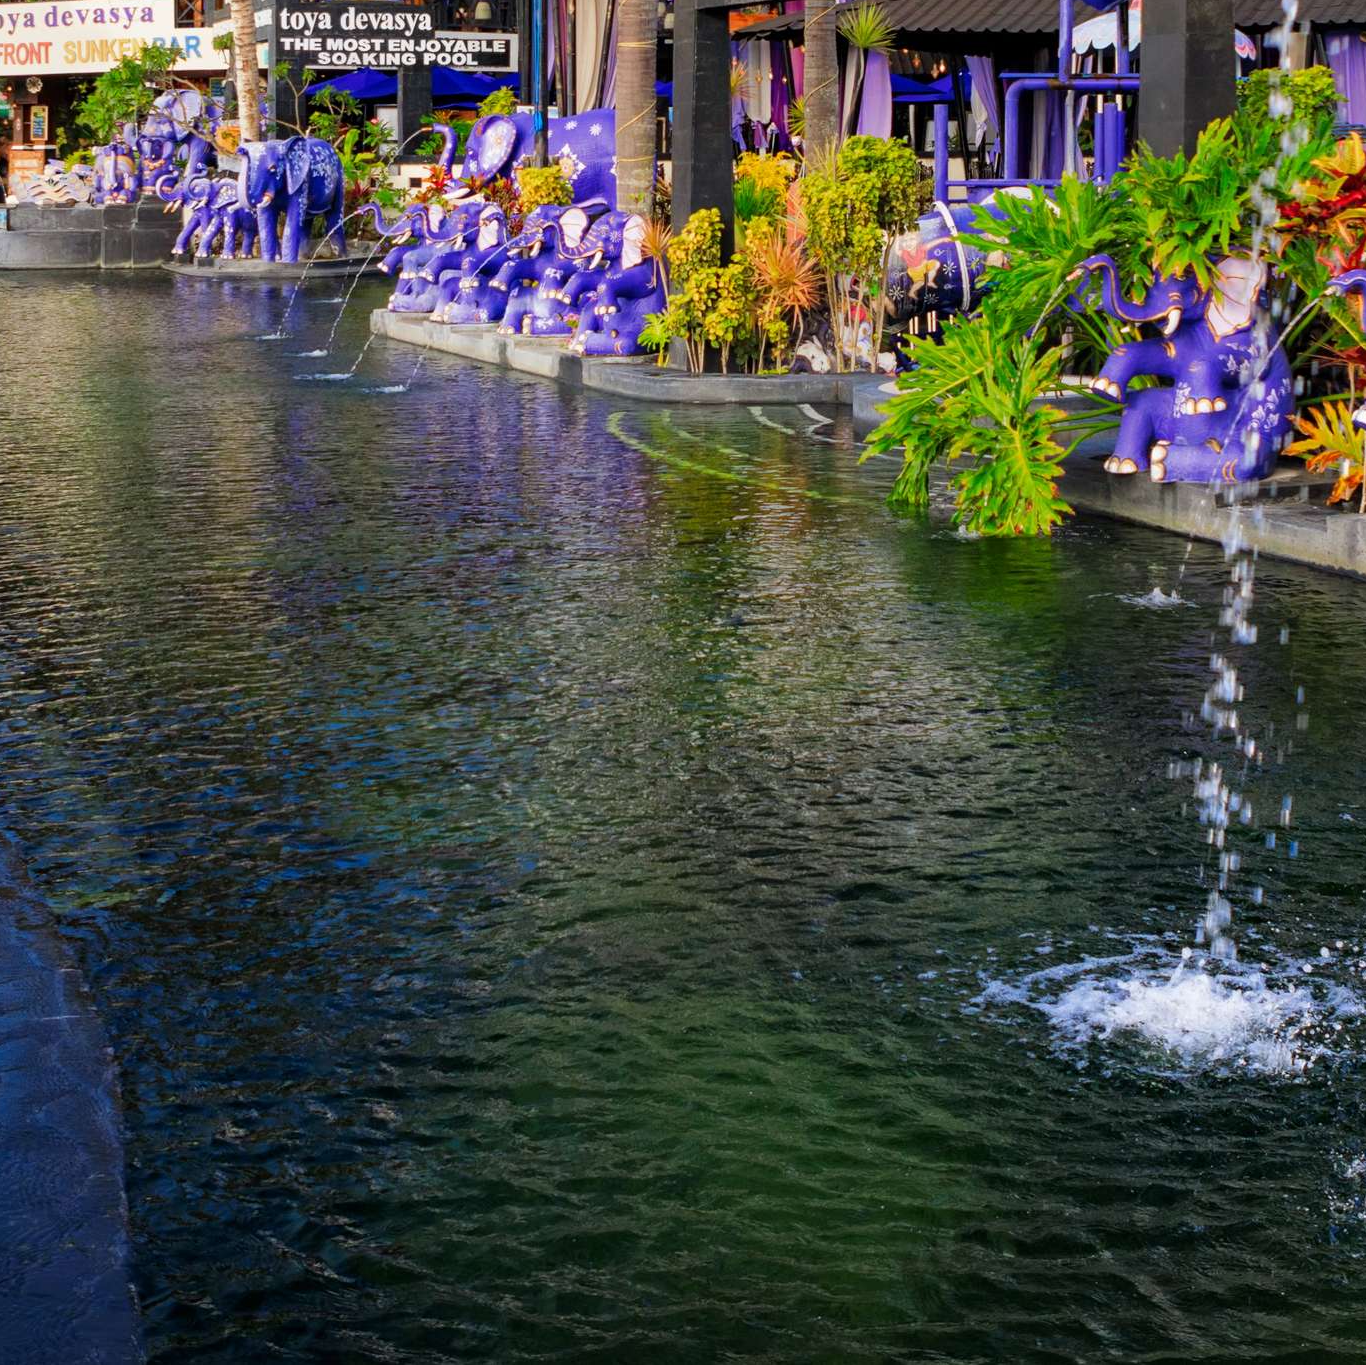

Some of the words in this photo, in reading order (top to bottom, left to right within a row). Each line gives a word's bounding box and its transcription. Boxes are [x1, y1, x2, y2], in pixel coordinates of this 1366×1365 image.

[44, 5, 154, 29] devasya
[280, 7, 333, 35] toya
[340, 7, 432, 35] devasya
[63, 38, 147, 64] SUNKEN
[280, 38, 322, 51] THE
[326, 39, 385, 52] MOST
[389, 39, 506, 53] ENJOYABLE
[317, 52, 417, 66] SOAKING
[423, 53, 478, 66] POOL
